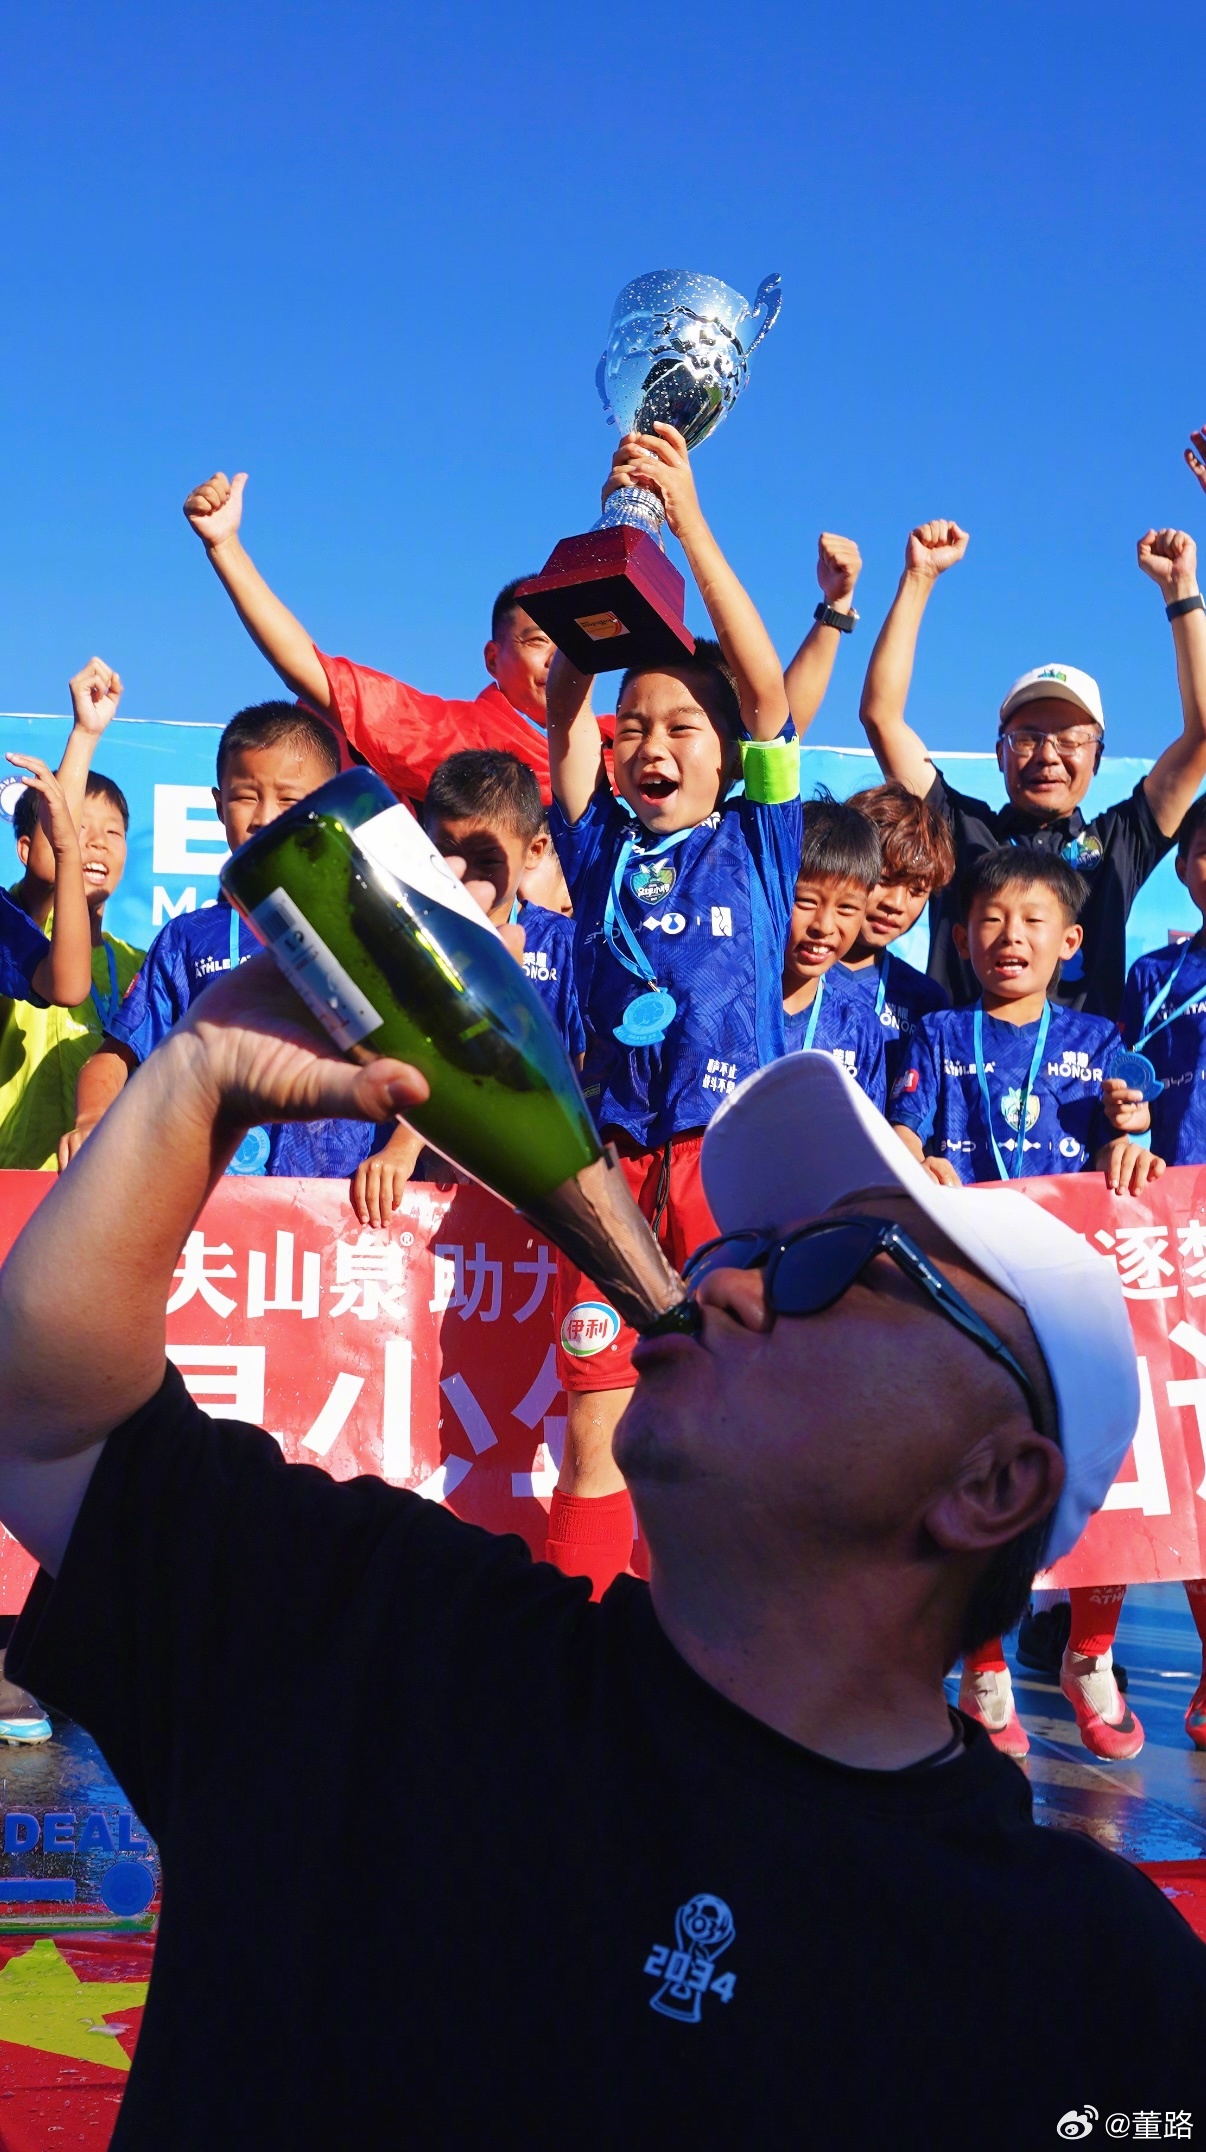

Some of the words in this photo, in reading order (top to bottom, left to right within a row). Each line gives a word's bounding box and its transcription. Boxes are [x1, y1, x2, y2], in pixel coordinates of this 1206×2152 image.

[152, 885, 218, 926] M
[944, 1062, 995, 1077] ATHLEA
[1047, 1061, 1103, 1082] HONOR
[566, 1318, 608, 1340] 伊利
[4, 1812, 149, 1852] DEAL
[643, 1943, 737, 2004] 2034
